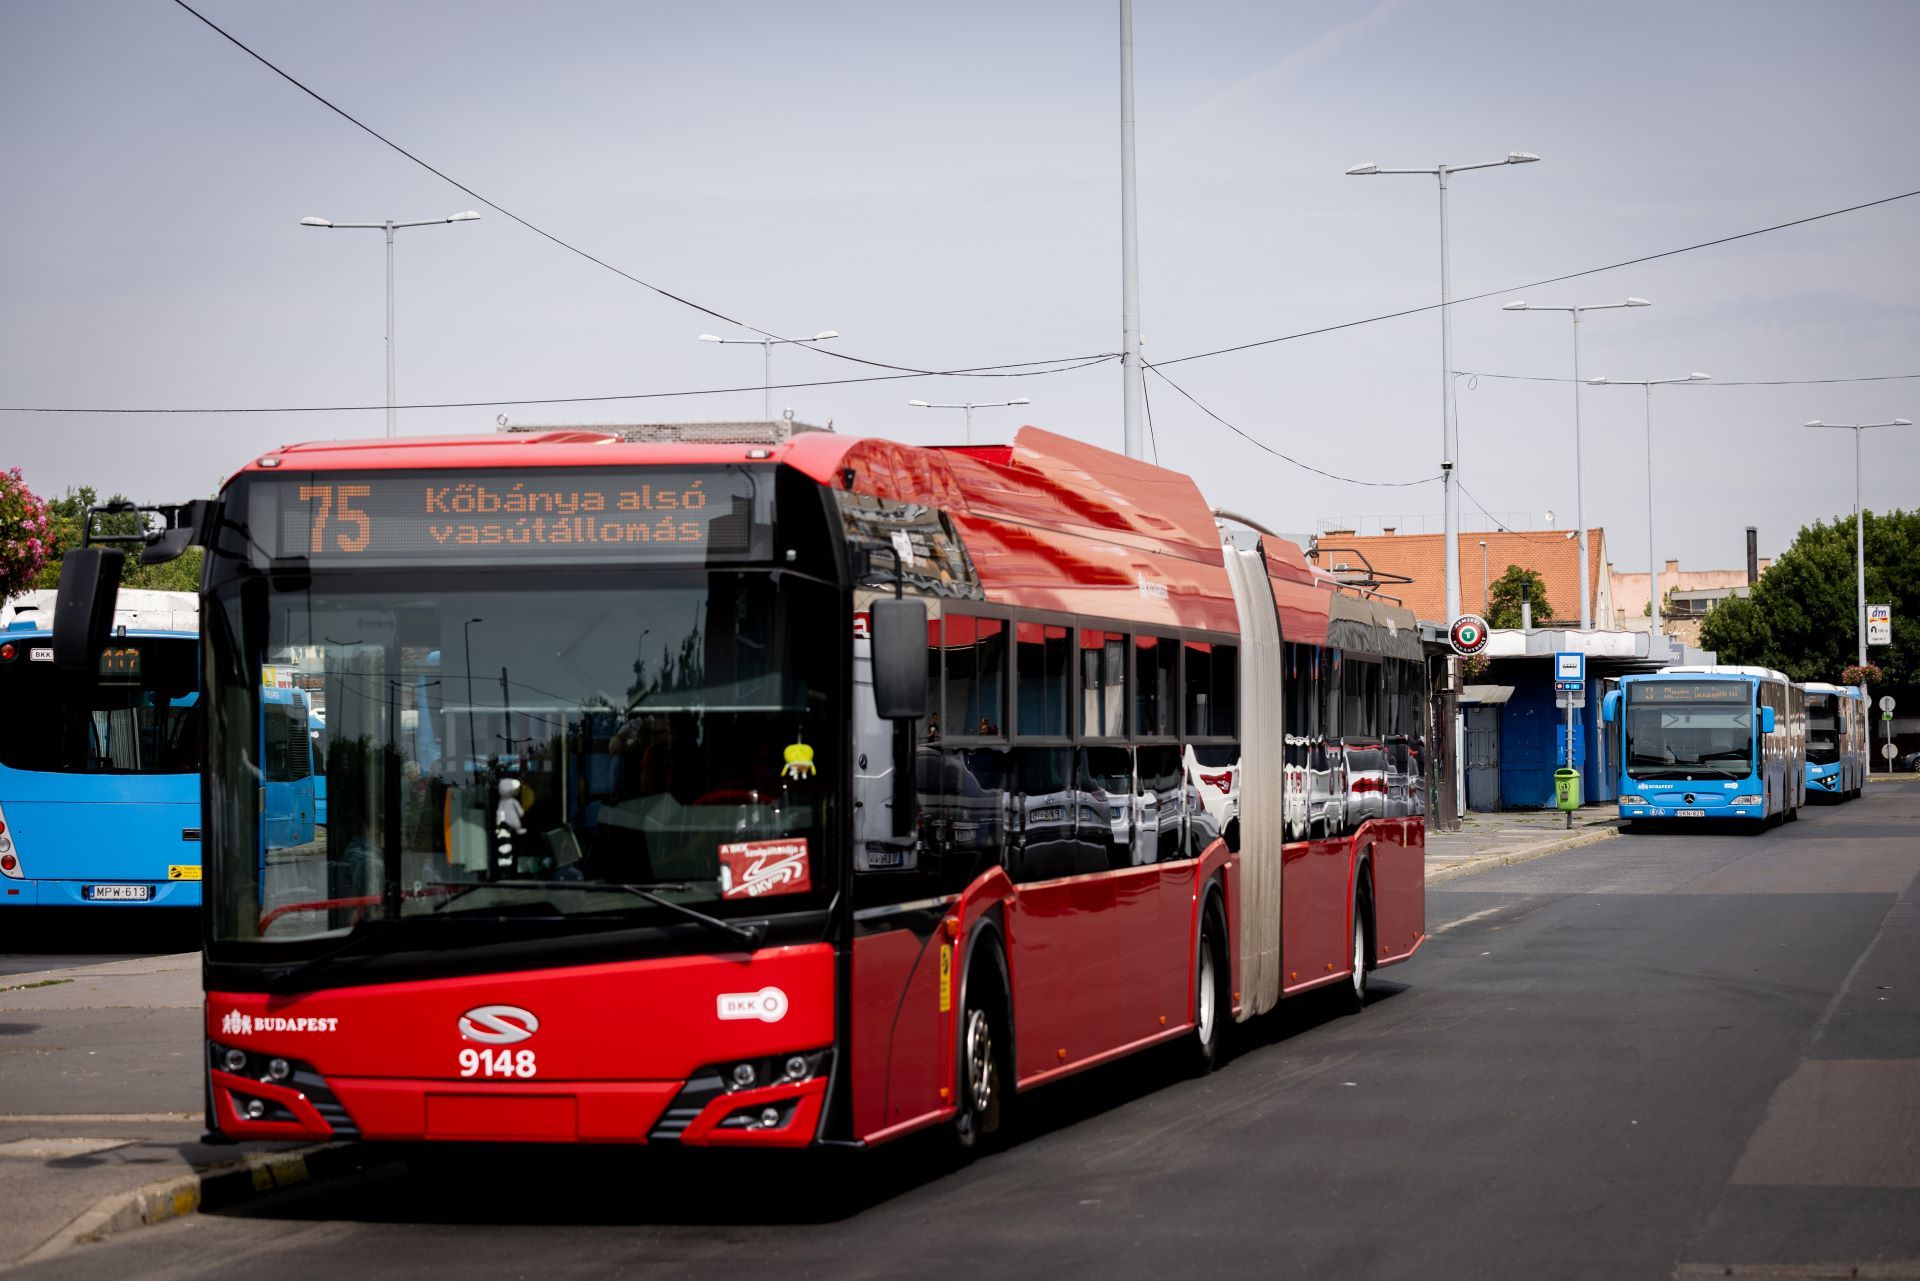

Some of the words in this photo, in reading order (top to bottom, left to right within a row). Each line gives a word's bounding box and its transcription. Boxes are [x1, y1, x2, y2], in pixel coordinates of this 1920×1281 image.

[425, 483, 606, 515] Kőbánya
[616, 480, 706, 510] alsó
[300, 485, 370, 552] 75
[428, 515, 704, 544] vasútállomás
[1872, 606, 1887, 618] dm
[1464, 631, 1472, 639] T
[96, 887, 146, 897] MPW-613
[728, 1000, 755, 1012] BKK
[254, 1017, 338, 1032] BUDAPEST
[458, 1048, 537, 1079] 9148
